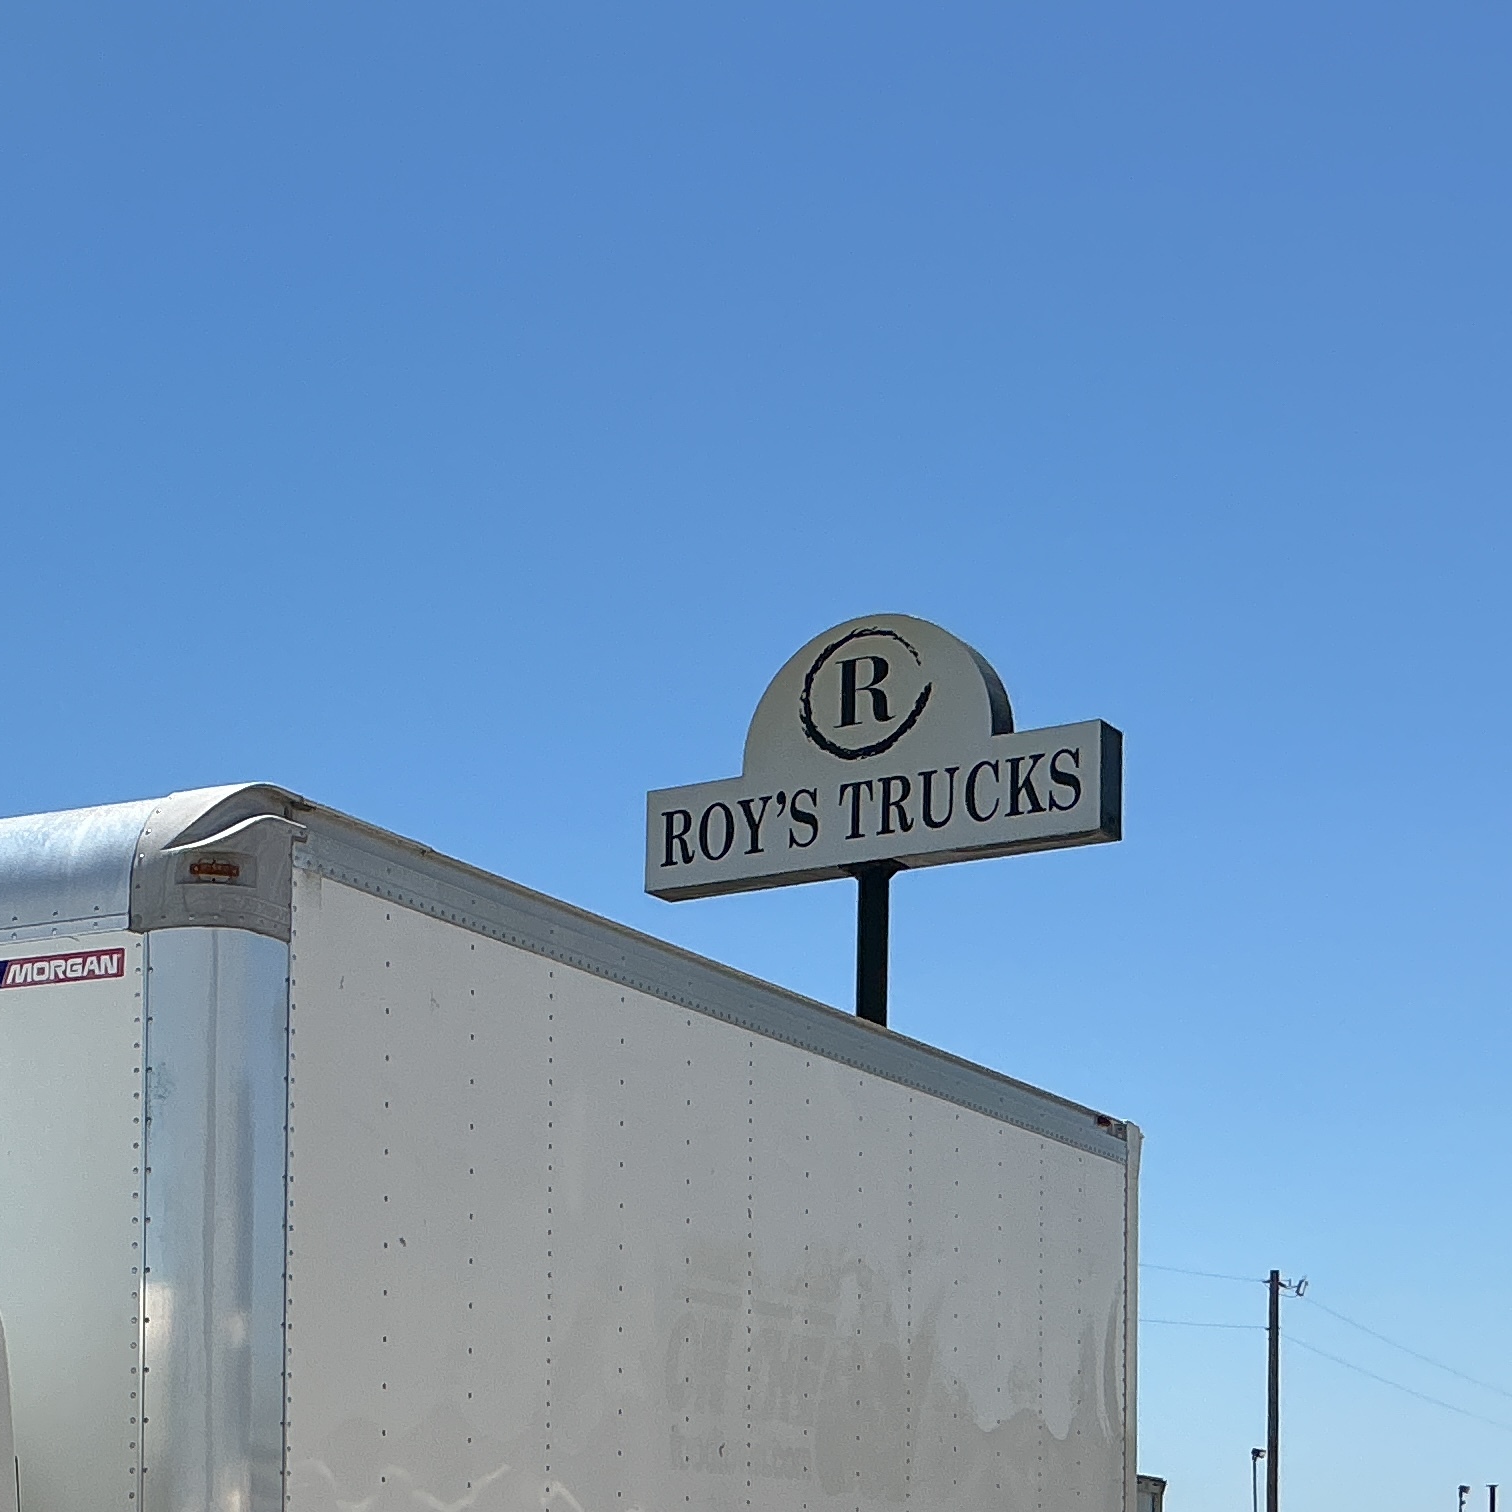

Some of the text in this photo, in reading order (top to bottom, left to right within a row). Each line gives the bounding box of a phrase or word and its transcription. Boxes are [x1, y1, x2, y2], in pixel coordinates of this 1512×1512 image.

[833, 654, 896, 729] R
[660, 748, 1082, 868] ROY'S TRUCKS
[6, 953, 120, 985] MORGAN
